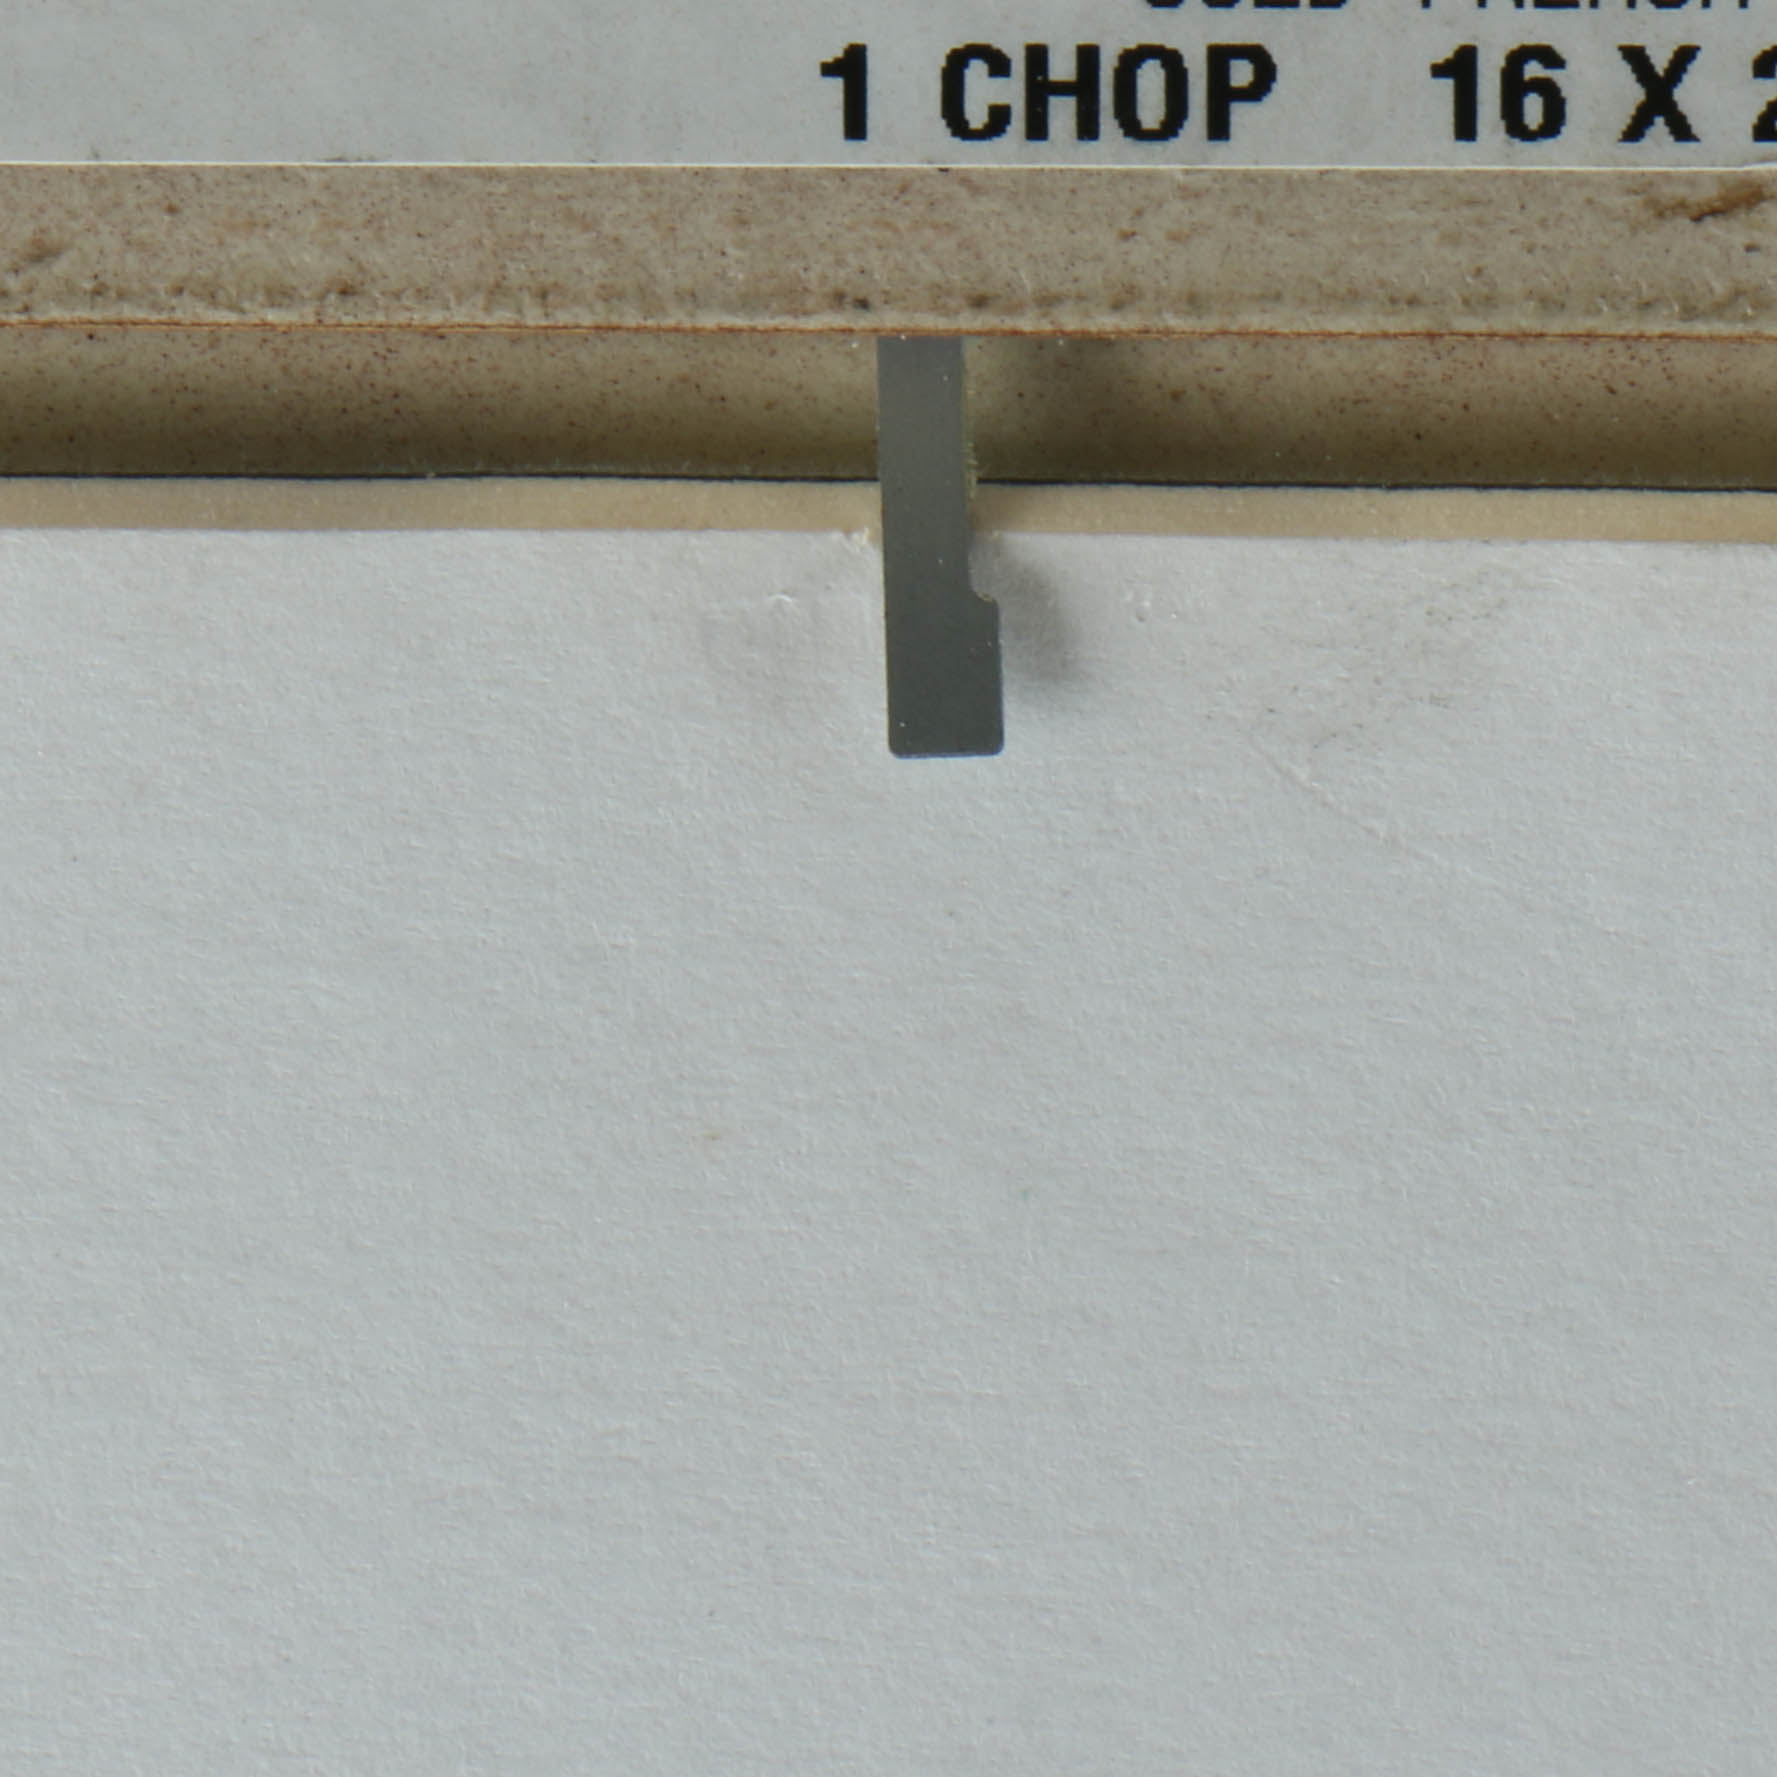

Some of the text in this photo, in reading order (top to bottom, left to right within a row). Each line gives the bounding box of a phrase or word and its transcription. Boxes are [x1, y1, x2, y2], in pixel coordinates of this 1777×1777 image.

[819, 43, 868, 142] 1
[940, 43, 1277, 142] CHOP
[1429, 44, 1567, 142] 16
[1617, 45, 1701, 143] X
